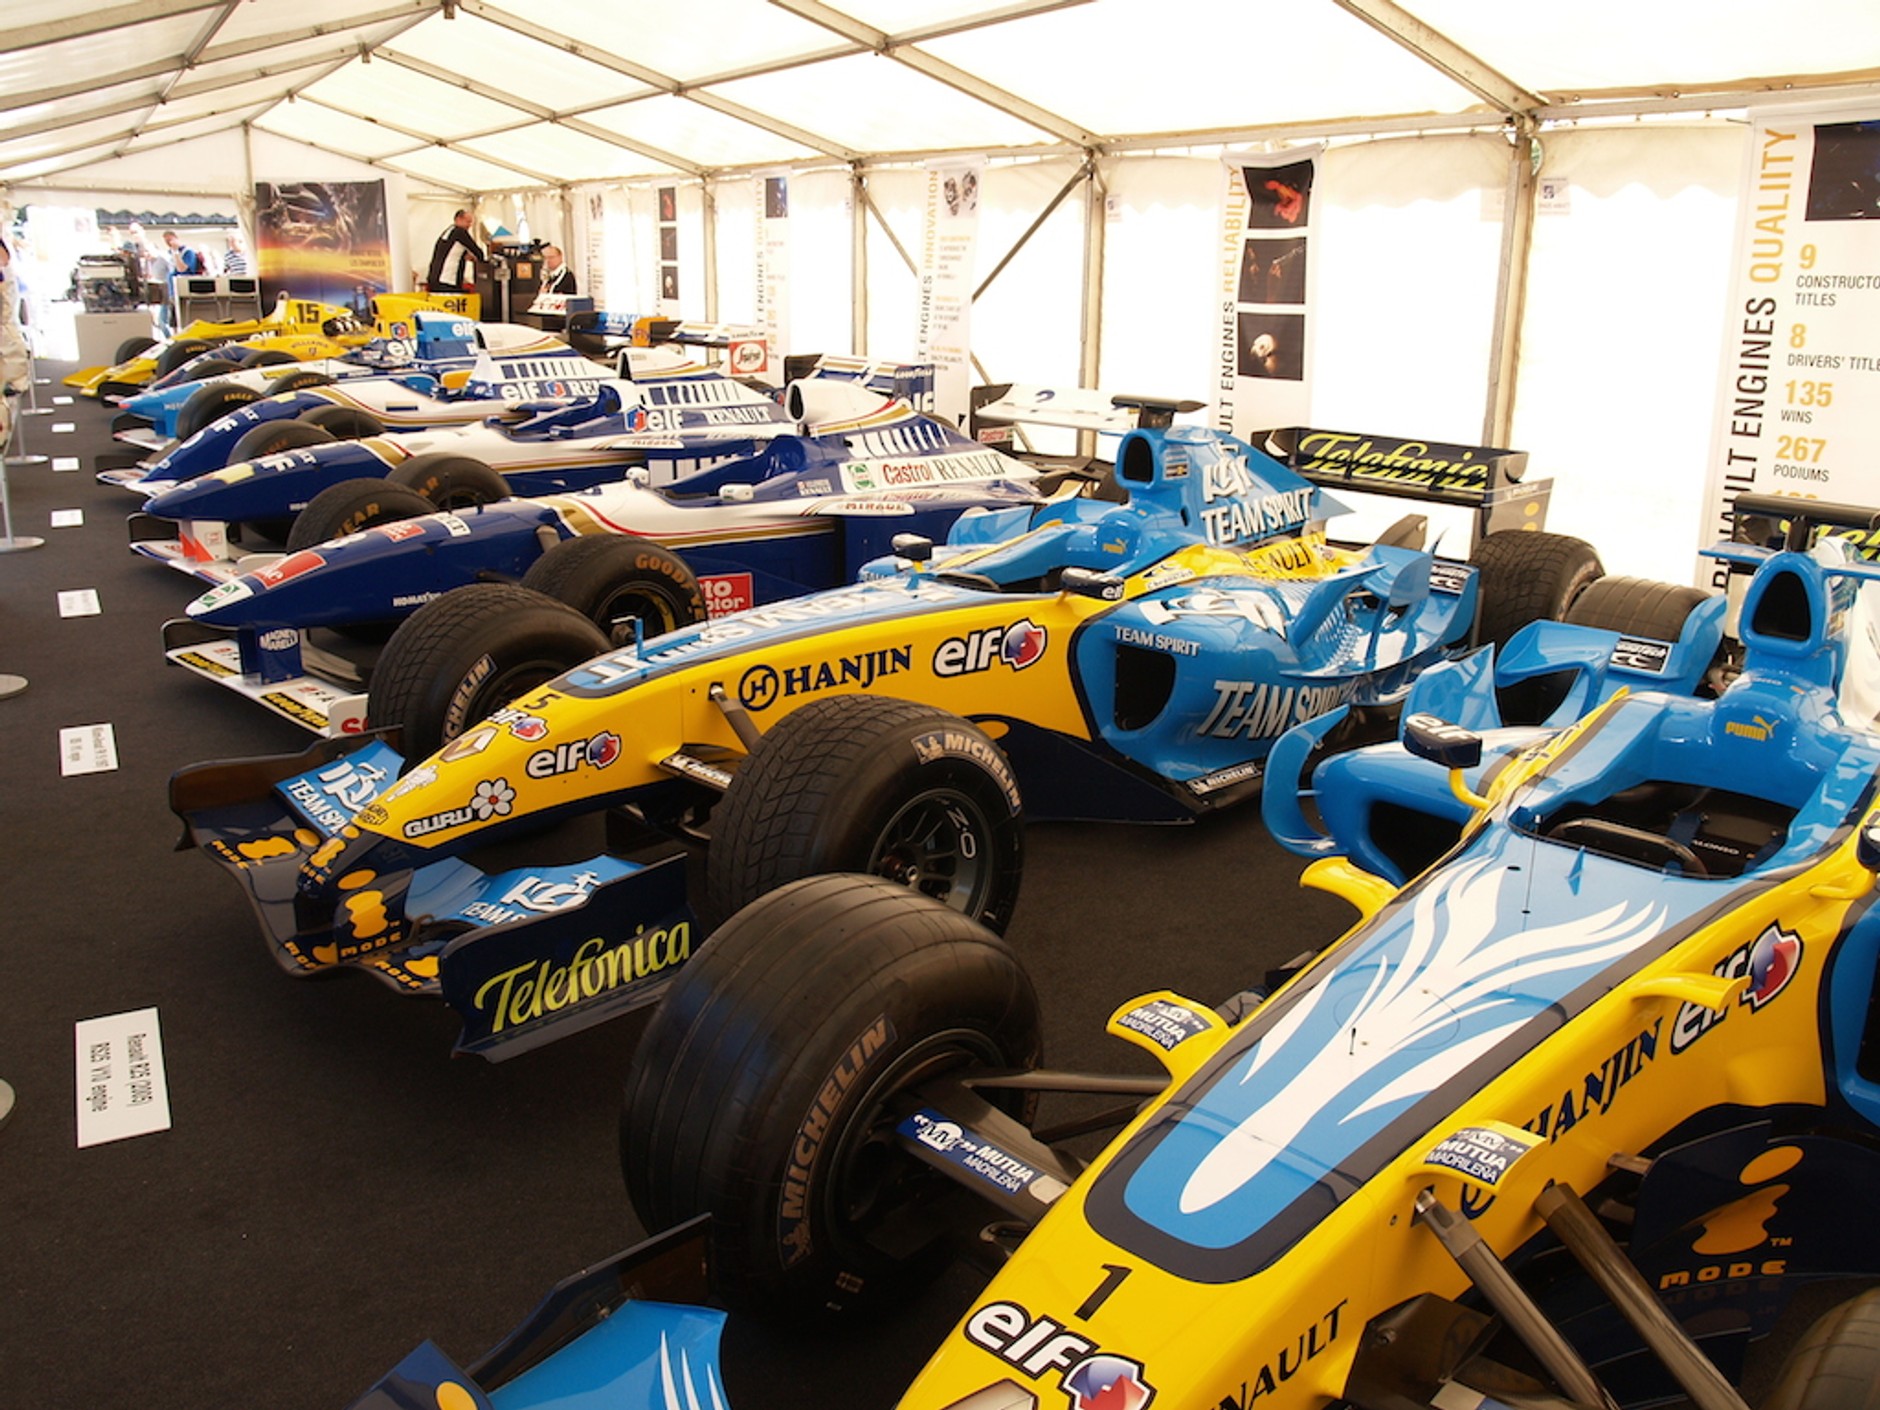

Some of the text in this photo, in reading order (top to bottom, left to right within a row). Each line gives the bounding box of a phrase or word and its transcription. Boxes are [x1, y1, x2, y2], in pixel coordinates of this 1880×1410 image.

[924, 171, 938, 269] INNOVATION
[1223, 165, 1247, 293] RELIABILITY
[1799, 244, 1817, 269] 9
[296, 303, 320, 324] 15
[444, 299, 467, 313] elf
[919, 276, 932, 345] ENGINES
[1795, 293, 1837, 307] TITLES
[387, 340, 417, 359] el
[1219, 301, 1235, 391] ENGINES
[1790, 323, 1807, 349] 8
[1731, 297, 1777, 438] ENGINES
[1787, 354, 1845, 370] DRIVERS'
[501, 382, 541, 400] elf
[1785, 380, 1834, 408] 135
[647, 405, 772, 431] elf RENAULT
[1780, 409, 1813, 424] WINS
[1776, 435, 1828, 463] 267
[882, 453, 1006, 485] Castrol RENAULT
[1773, 464, 1830, 482] PODIUMS
[1202, 487, 1316, 546] TEAM SPIRIT
[1102, 582, 1123, 599] elf
[935, 628, 1003, 676] elf
[1115, 626, 1201, 657] TEAM SPIRIT
[784, 645, 914, 697] HANJIN
[523, 693, 562, 710] 5
[1196, 679, 1291, 739] TEAM
[1405, 714, 1472, 742] elf
[1725, 721, 1767, 742] PUMA
[526, 741, 589, 778] elf
[945, 733, 1022, 809] MICHELIN
[287, 778, 335, 817] TEAM
[404, 808, 473, 838] GURU
[459, 901, 514, 925] TEAM
[340, 931, 402, 958] MODE
[1127, 1006, 1188, 1042] MUTUA
[1522, 1016, 1664, 1145] HANJIN
[86, 1084, 113, 1113] engine
[781, 1016, 889, 1219] MICHELIN
[974, 1144, 1036, 1182] MUTUA
[1427, 1150, 1497, 1183] MADRILEÑA
[1436, 1139, 1507, 1171] MUTUA
[1658, 1259, 1788, 1291] MODE
[1073, 1263, 1133, 1322] 1
[966, 1304, 1091, 1374] elf
[1206, 1298, 1349, 1410] NAULT
